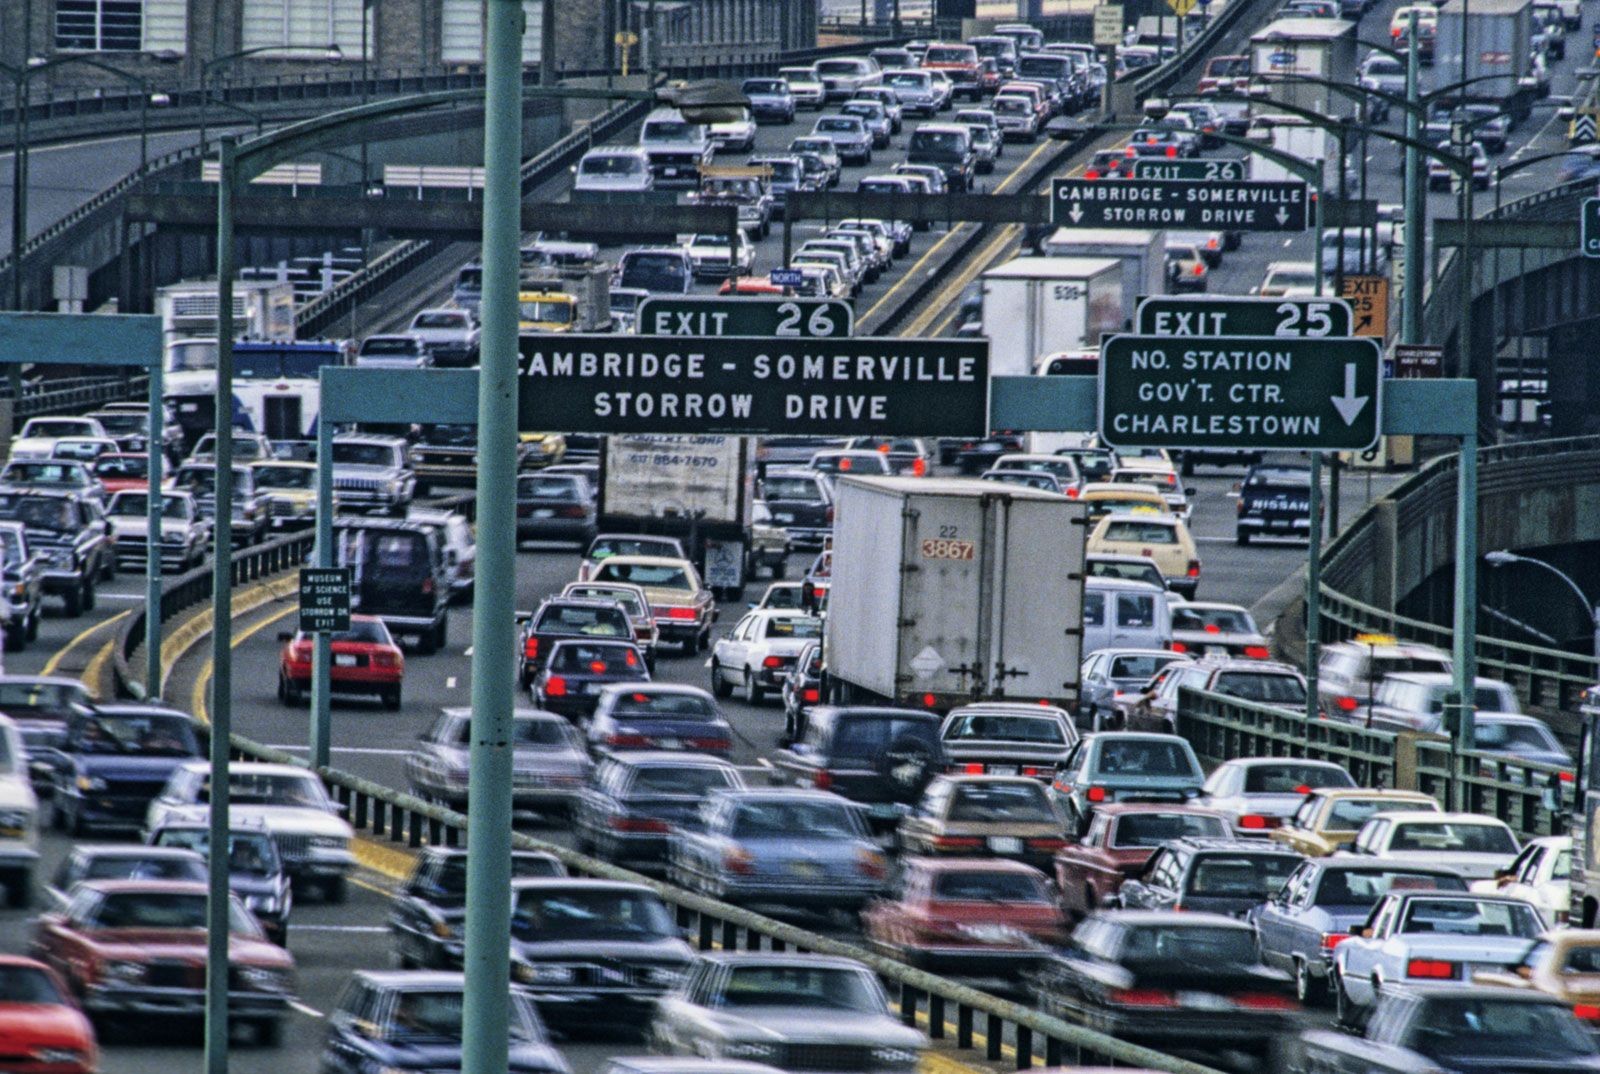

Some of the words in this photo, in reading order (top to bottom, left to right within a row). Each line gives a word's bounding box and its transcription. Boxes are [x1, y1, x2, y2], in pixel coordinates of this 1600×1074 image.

[1142, 166, 1180, 179] EXIT
[1205, 163, 1235, 180] 26
[1058, 186, 1163, 201] CAMBRIDGE
[1186, 188, 1301, 203] SOMERVILLE
[1103, 207, 1186, 222] STORROW
[1202, 208, 1255, 222] DRIVE
[772, 273, 801, 282] NORTH
[1342, 280, 1381, 294] EXIT
[655, 312, 729, 336] EXIT
[775, 303, 835, 337] 26
[1155, 312, 1227, 336] EXIT
[1275, 303, 1332, 337] 25
[753, 354, 976, 382] SOMERVILLE
[1131, 350, 1170, 370] NO.
[1182, 351, 1292, 371] STATION
[1229, 383, 1285, 404] CTR.
[594, 392, 753, 419] STORROW
[785, 394, 888, 420] DRIVE
[1113, 414, 1321, 435] CHARLESTOWN
[1252, 499, 1309, 511] NISSAN
[939, 525, 958, 538] 22
[922, 540, 973, 560] 3867
